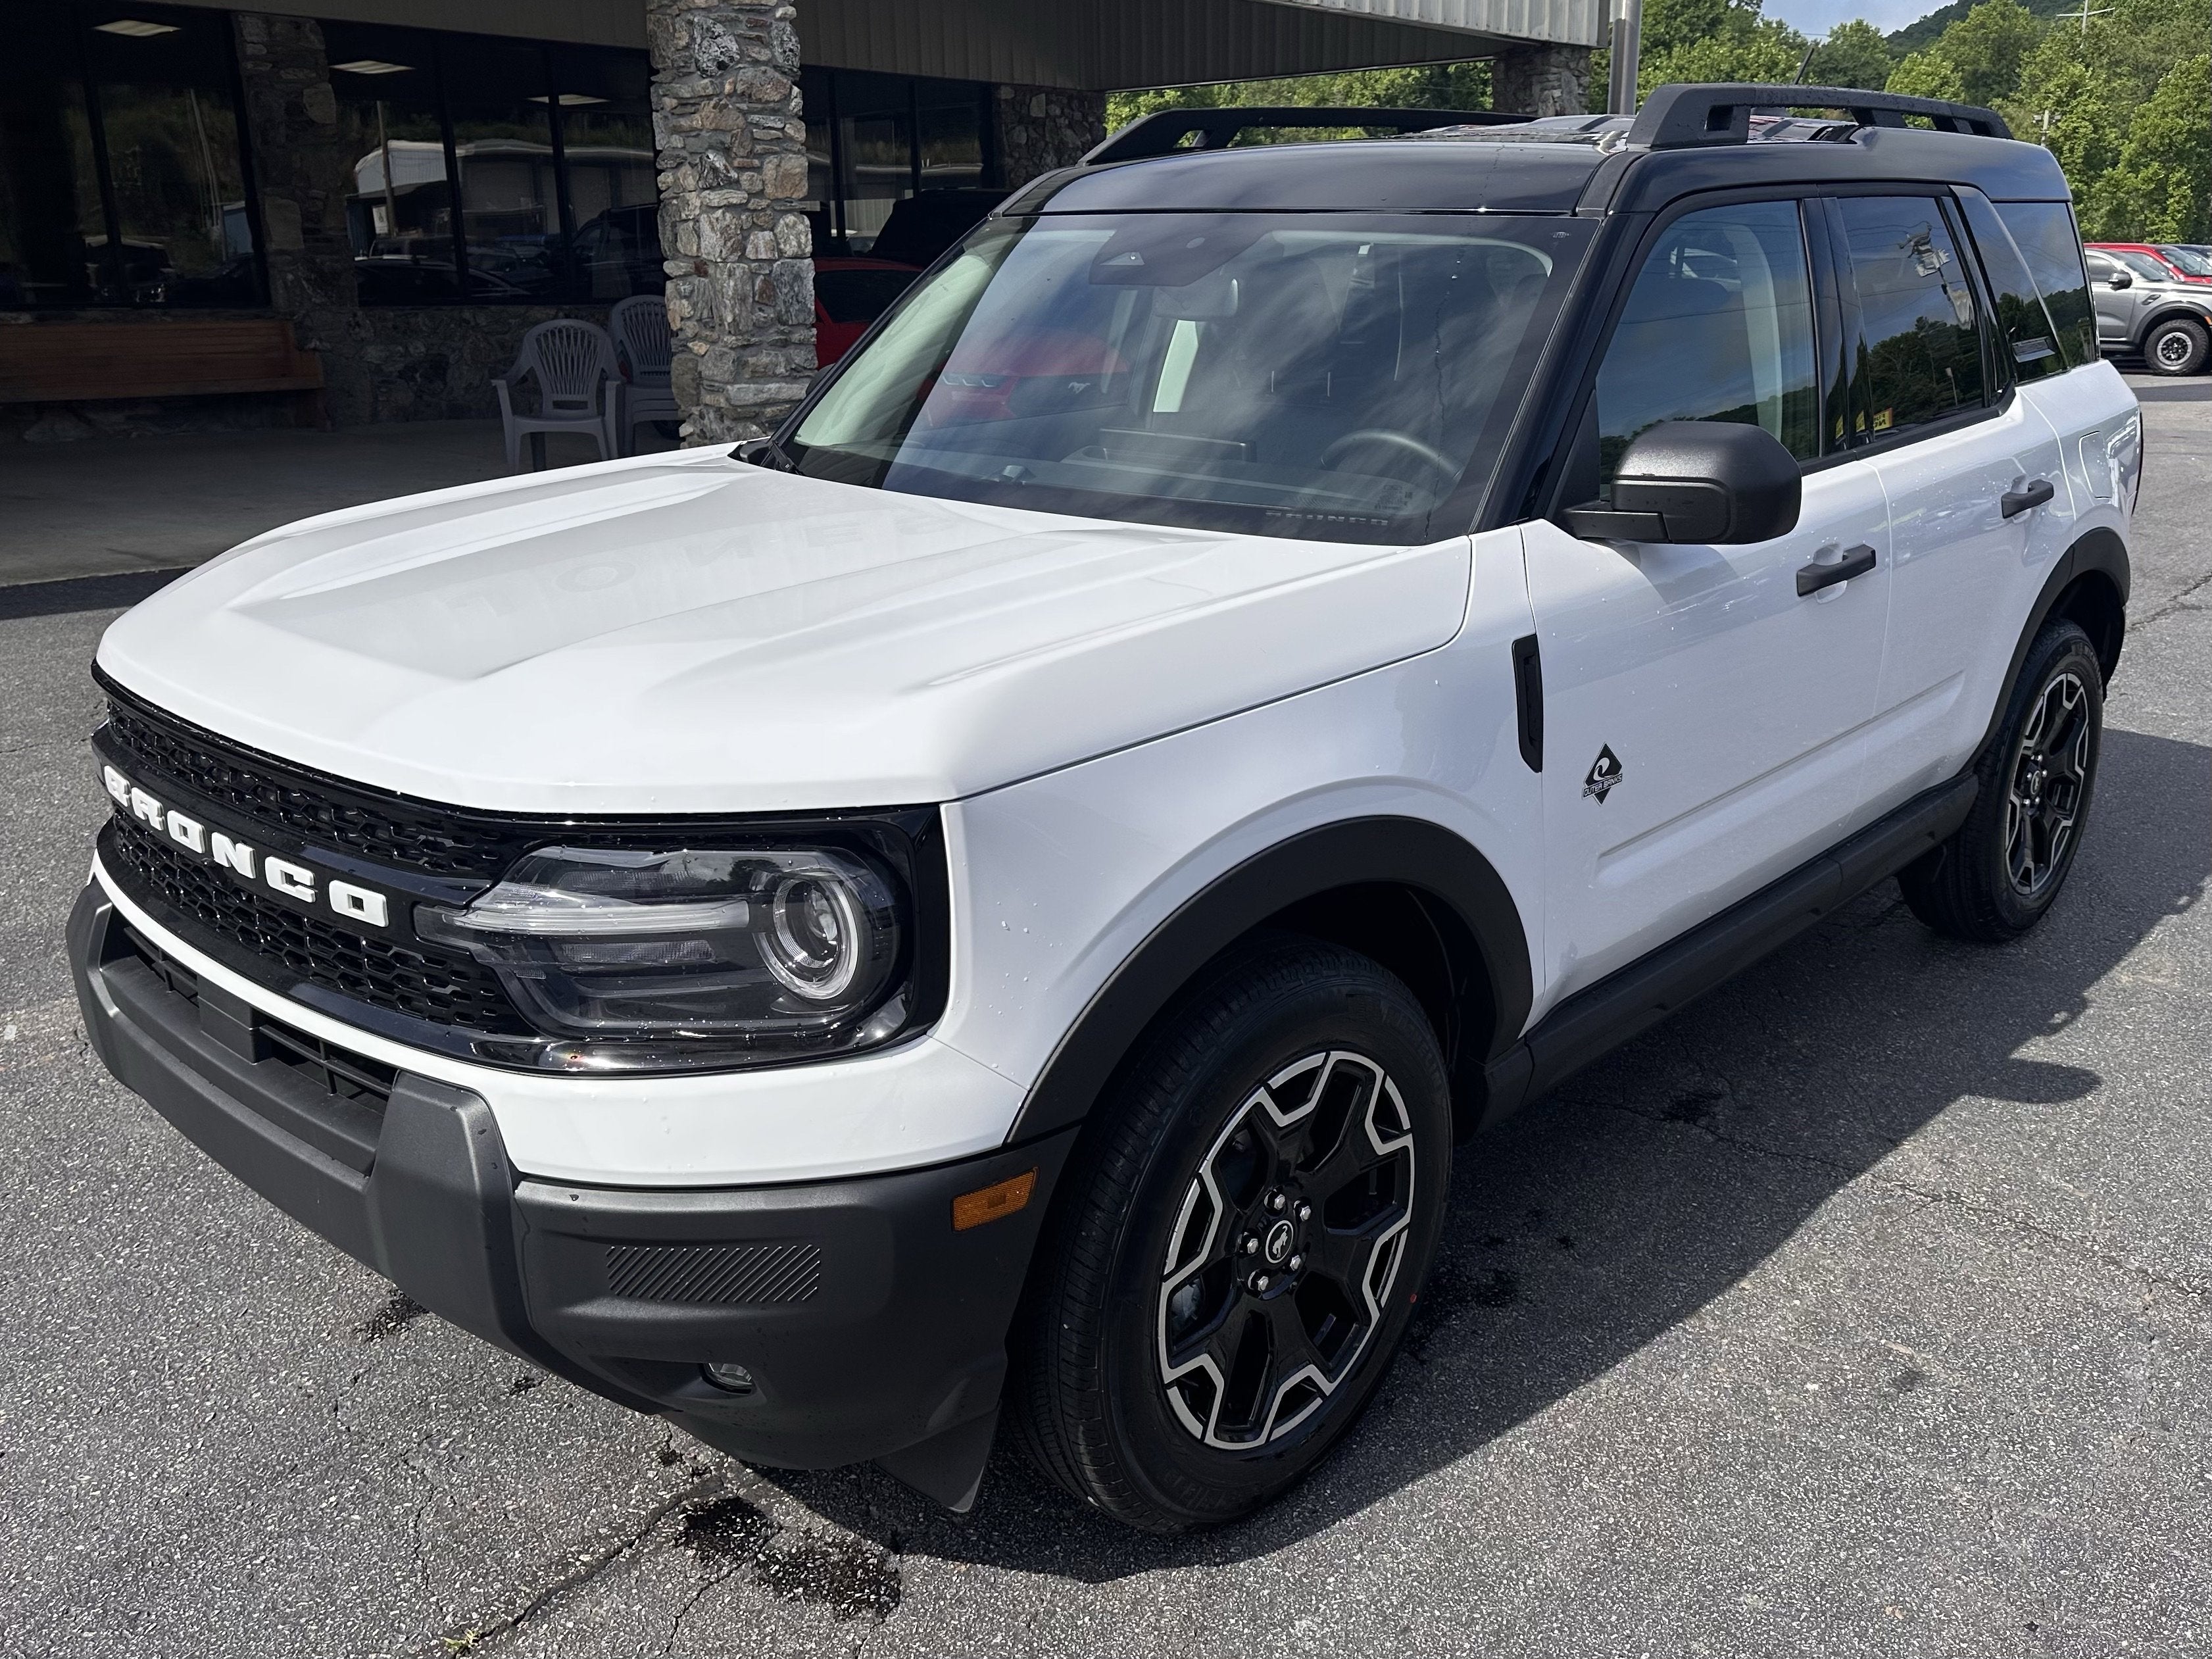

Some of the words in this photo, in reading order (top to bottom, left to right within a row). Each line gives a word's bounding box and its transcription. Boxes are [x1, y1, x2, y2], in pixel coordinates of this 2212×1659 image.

[1584, 782, 1602, 796] OUTER
[1603, 775, 1622, 789] BANKS
[104, 764, 390, 928] BRONCO
